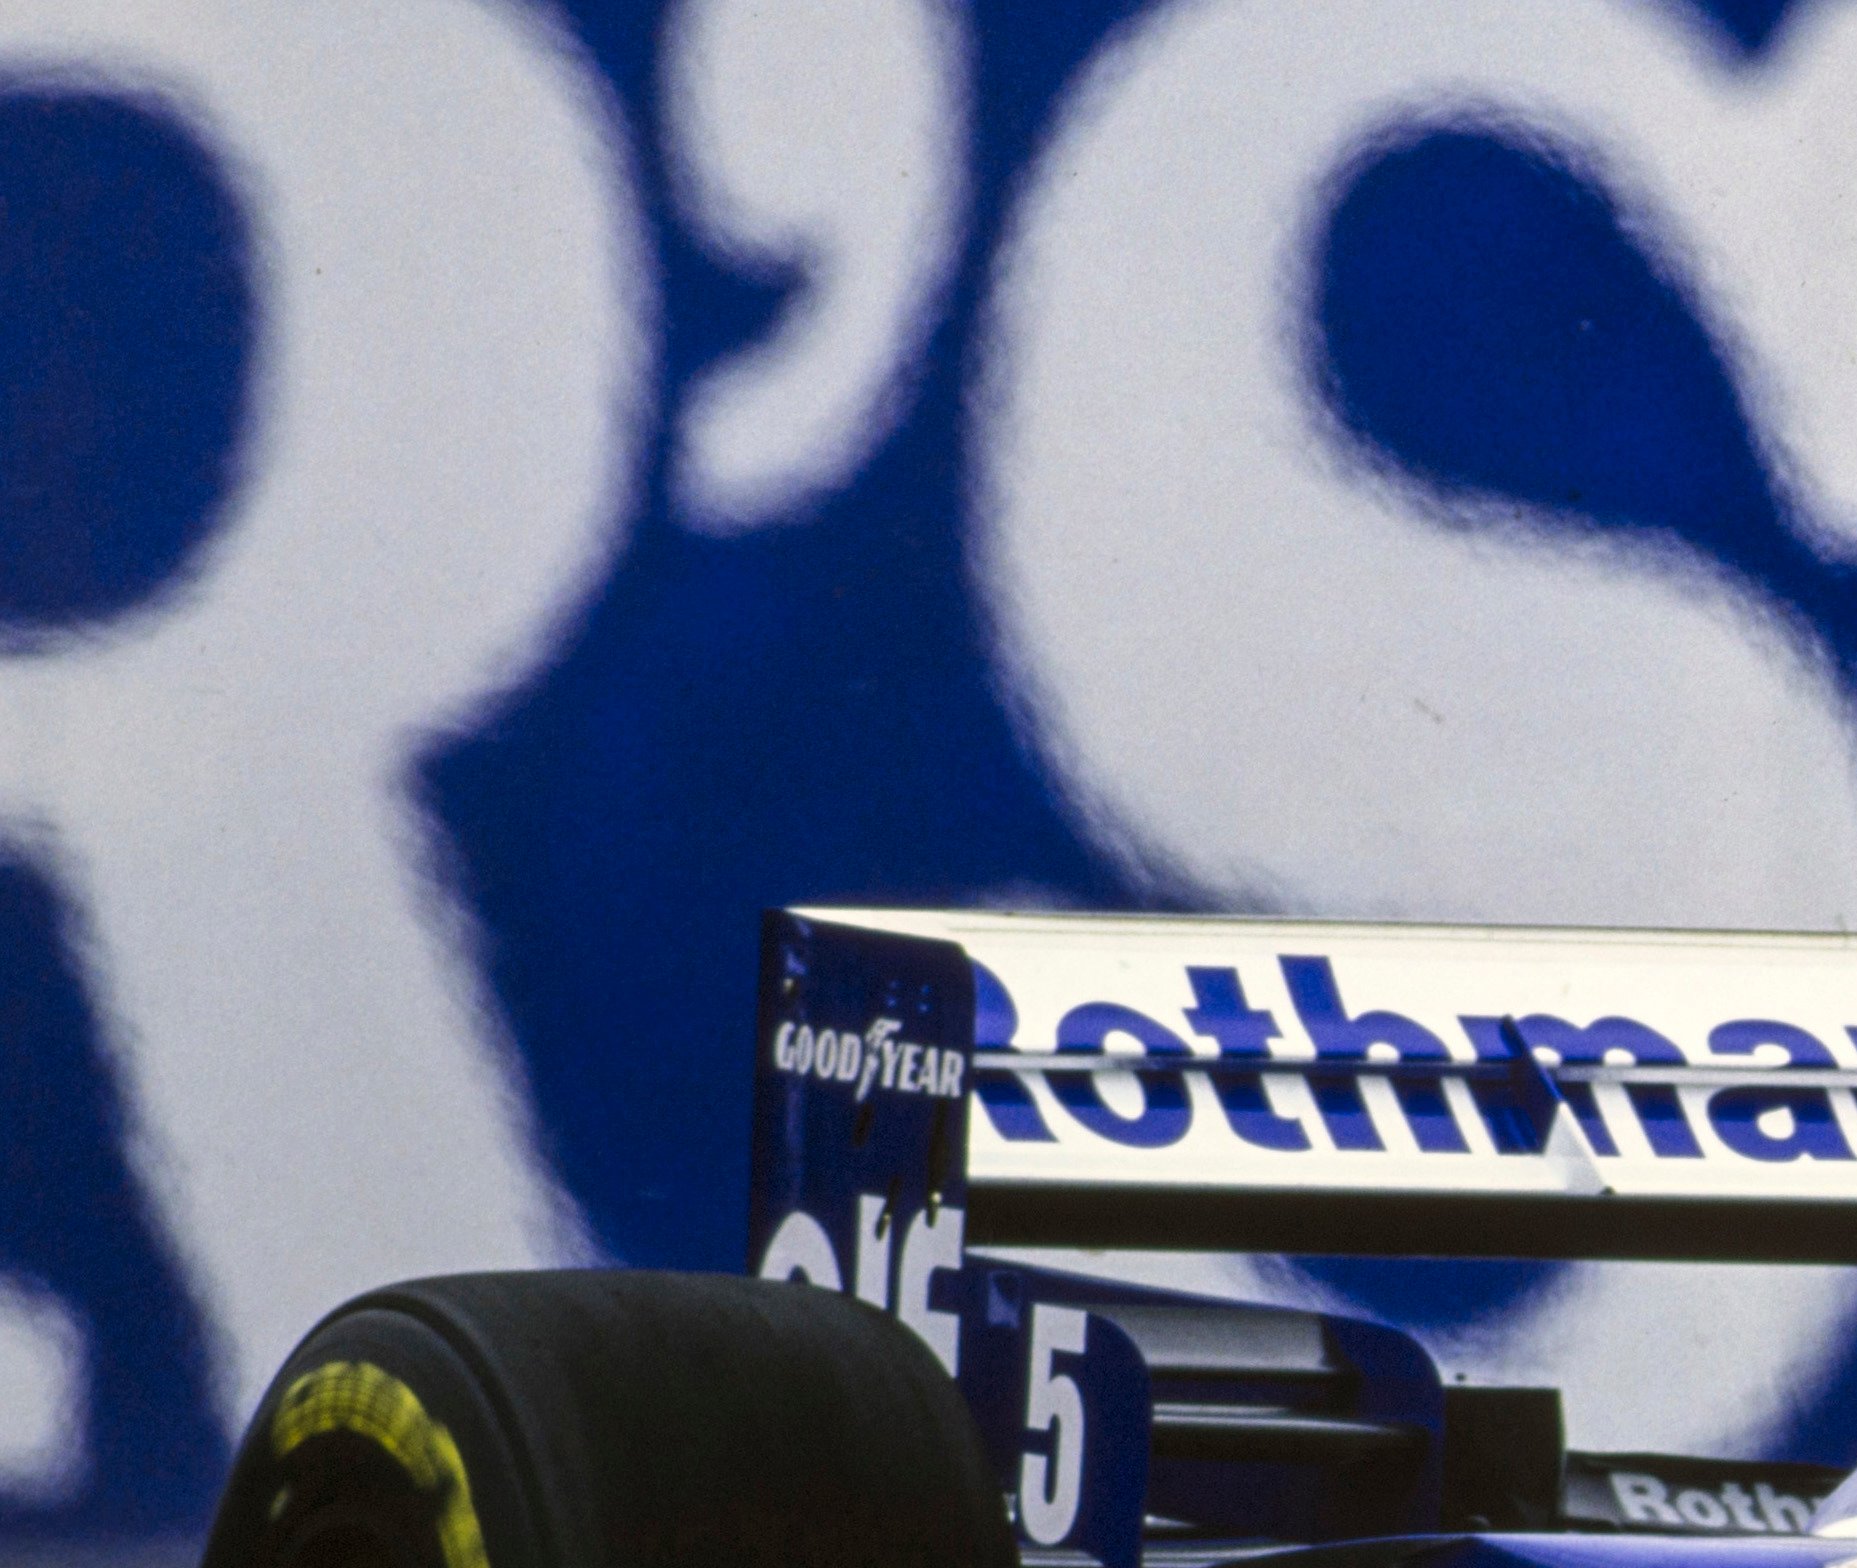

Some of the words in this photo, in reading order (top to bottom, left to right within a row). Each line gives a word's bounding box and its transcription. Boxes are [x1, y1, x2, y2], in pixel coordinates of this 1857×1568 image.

[773, 1018, 963, 1101] GOODYEAR
[1019, 1302, 1088, 1546] 5
[1609, 1471, 1824, 1533] Roth
